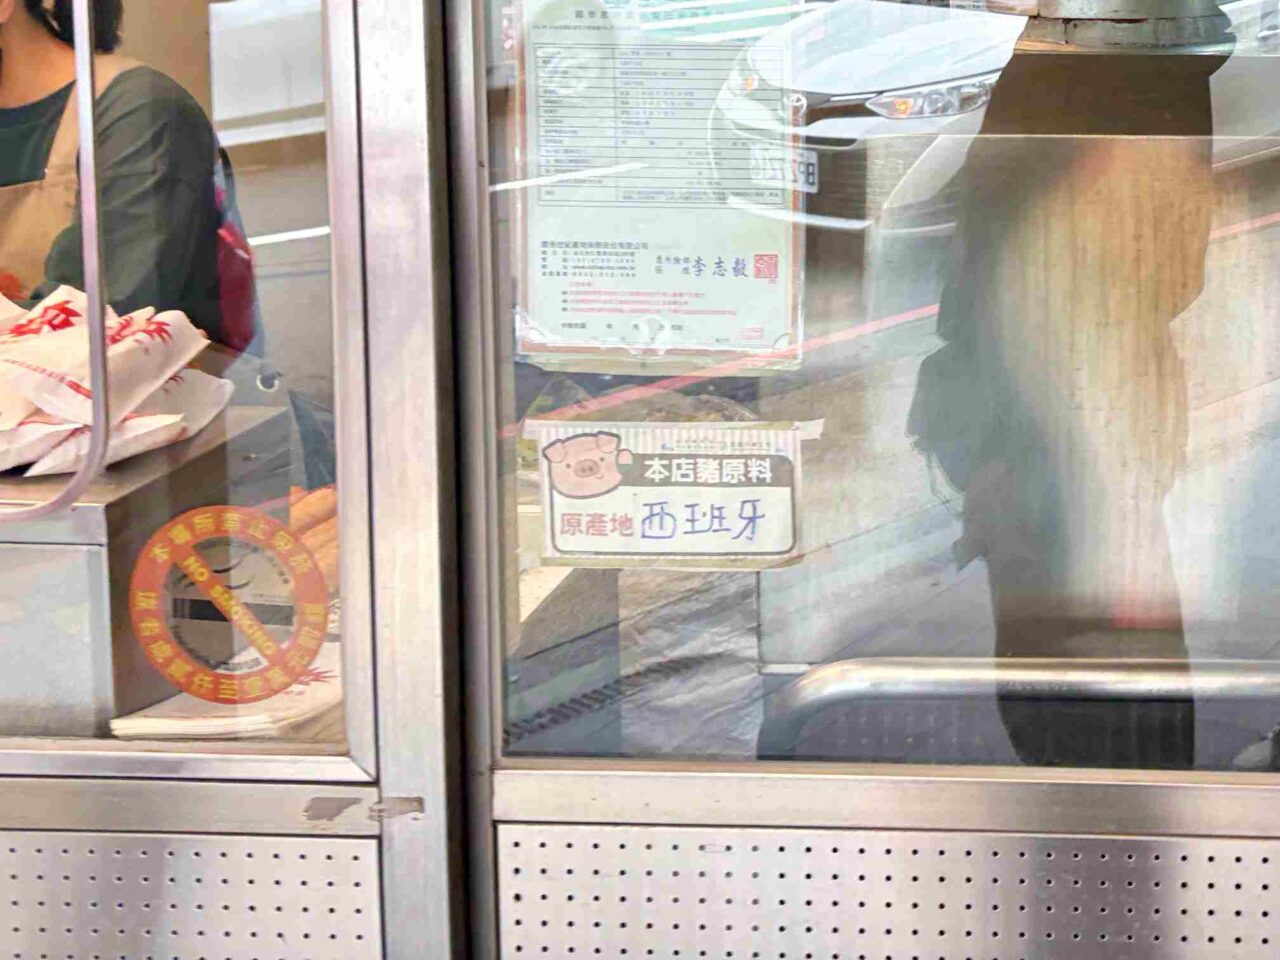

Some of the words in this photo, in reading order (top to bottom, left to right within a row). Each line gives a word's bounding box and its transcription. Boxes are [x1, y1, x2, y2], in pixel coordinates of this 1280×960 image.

[644, 457, 773, 484] 本店豬原料
[560, 512, 634, 538] 原產地
[640, 498, 766, 541] 西班牙
[183, 555, 209, 581] NO
[209, 584, 278, 656] SMOKING
